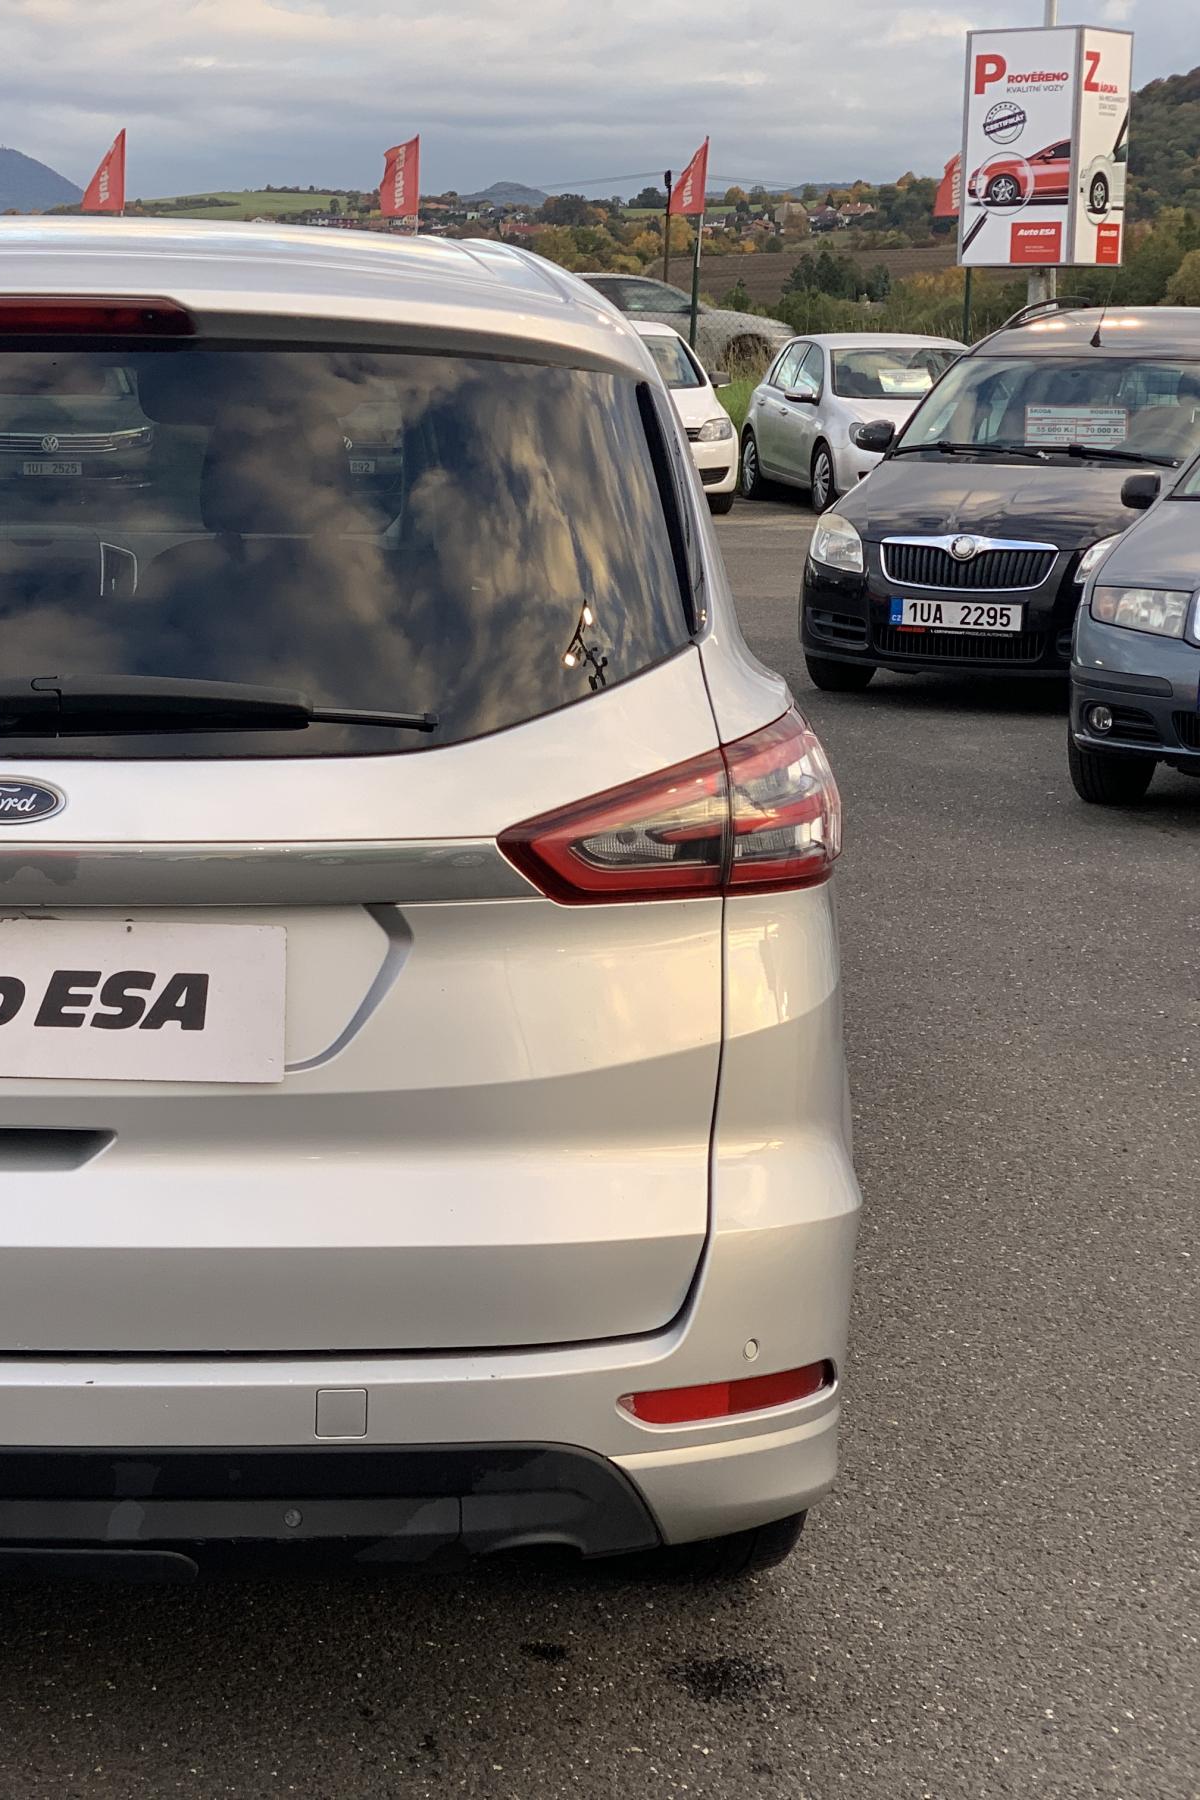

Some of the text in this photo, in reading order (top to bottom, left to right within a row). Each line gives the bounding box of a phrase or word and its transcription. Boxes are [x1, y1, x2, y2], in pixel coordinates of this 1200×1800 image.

[1006, 84, 1064, 94] KVALITNÍ VOZY
[1039, 228, 1056, 236] ESA
[909, 602, 1012, 627] 1UA 2295
[34, 970, 209, 1031] ESA
